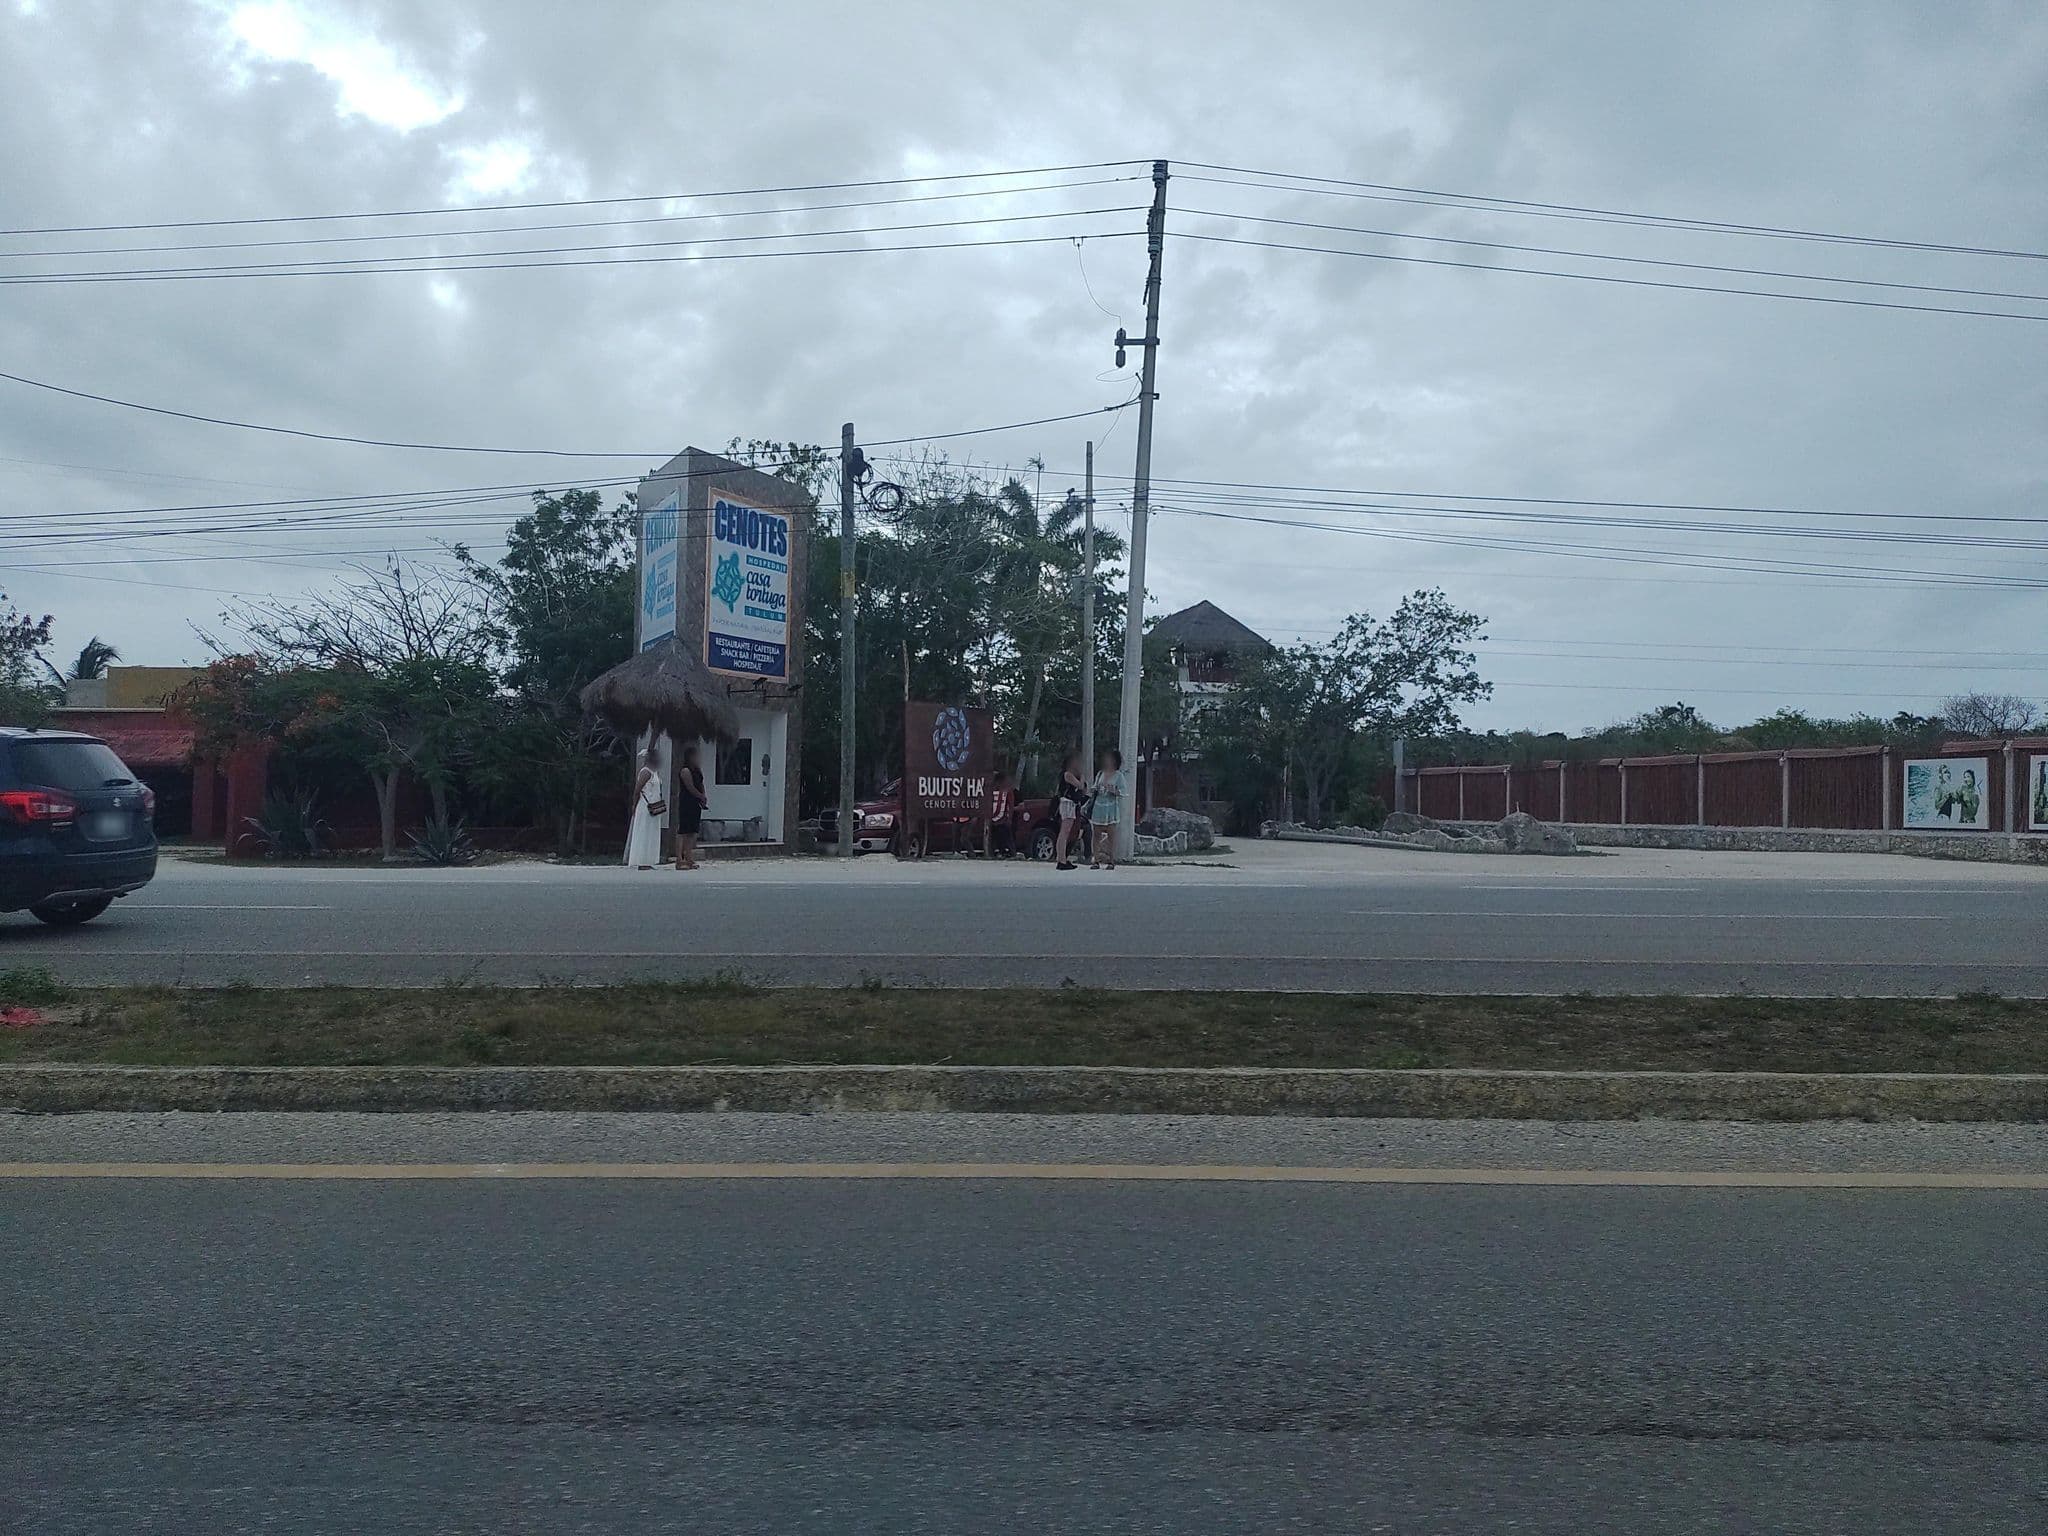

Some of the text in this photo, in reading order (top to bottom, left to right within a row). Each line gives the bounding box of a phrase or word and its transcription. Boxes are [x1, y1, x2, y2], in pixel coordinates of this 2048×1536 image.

[715, 500, 788, 557] CENOTES
[747, 571, 771, 588] casa
[746, 584, 786, 609] tortuga
[715, 637, 751, 651] RESTAURANTE
[721, 647, 738, 659] SNACK
[739, 651, 749, 660] BAR
[733, 659, 762, 671] HOSPEDAJE
[924, 799, 980, 809] CENOTE CLUB
